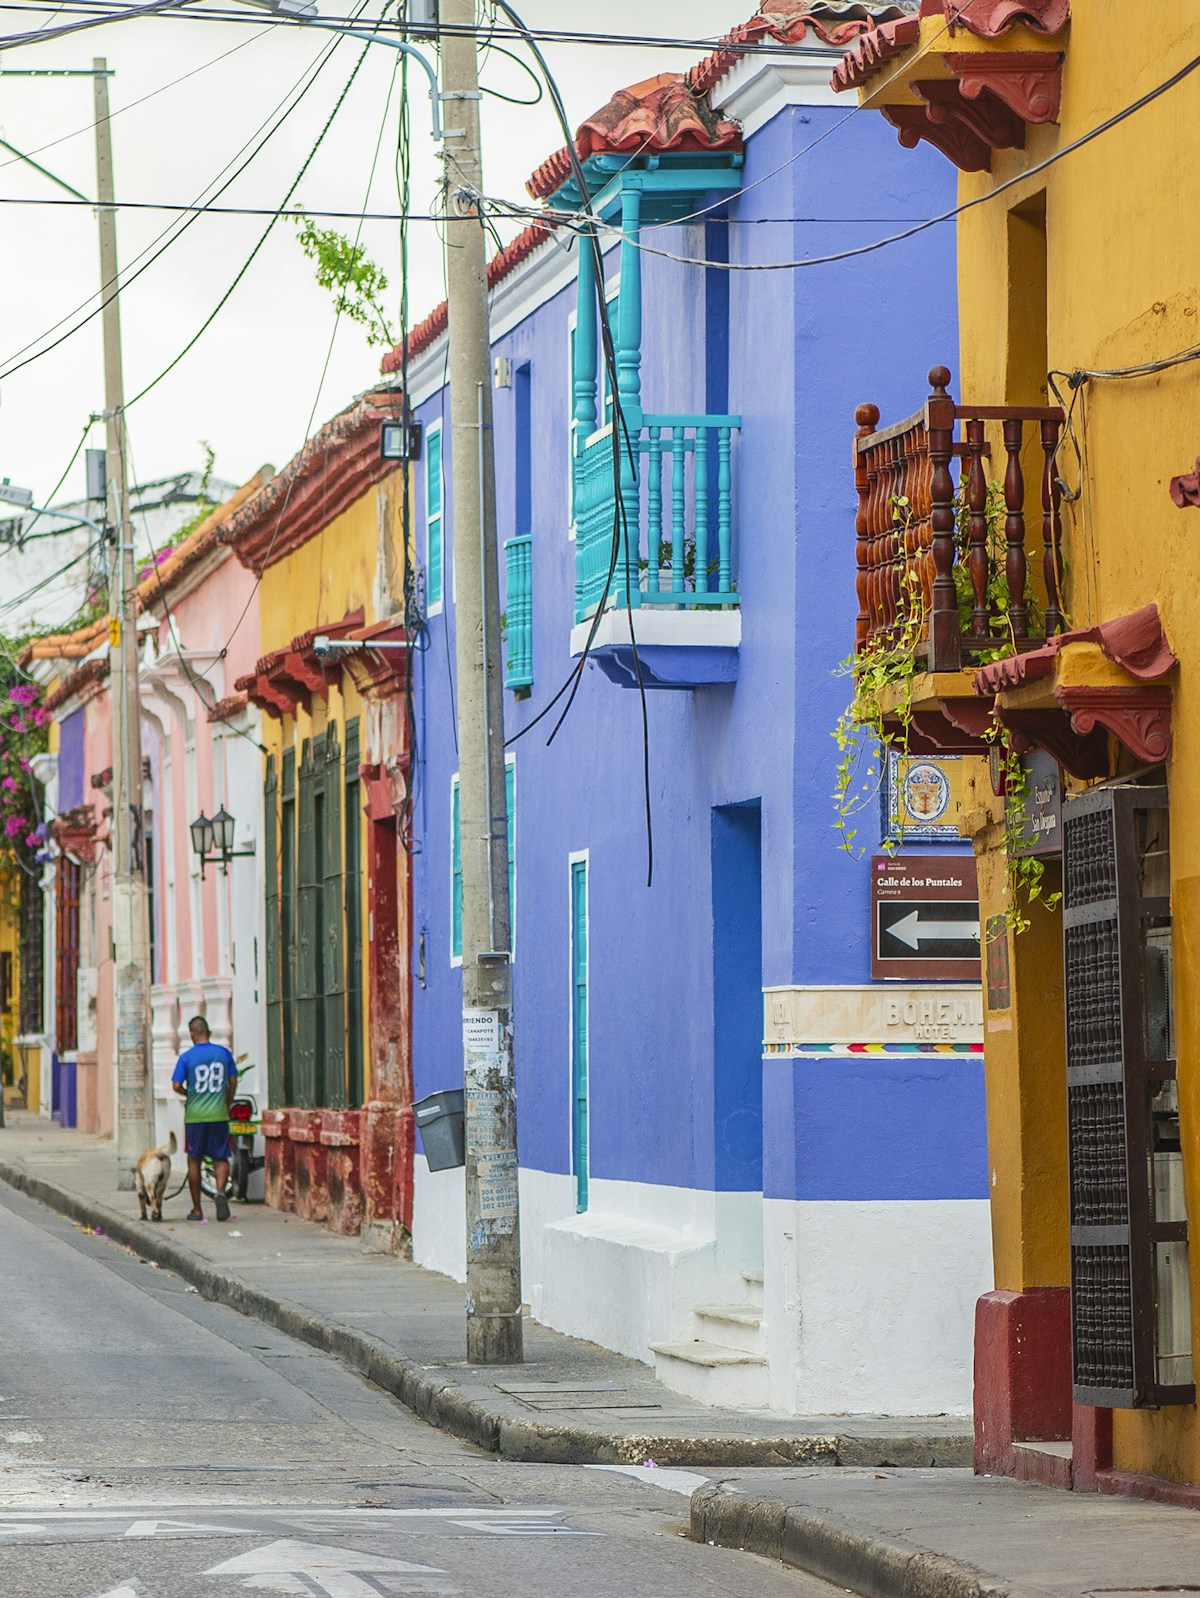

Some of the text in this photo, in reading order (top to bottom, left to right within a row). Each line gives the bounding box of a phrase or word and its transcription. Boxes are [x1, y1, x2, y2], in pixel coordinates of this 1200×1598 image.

[1031, 813, 1040, 832] San
[877, 877, 963, 887] Calle de los Puntales
[915, 1027, 957, 1040] HOTEL
[194, 1061, 225, 1093] 88
